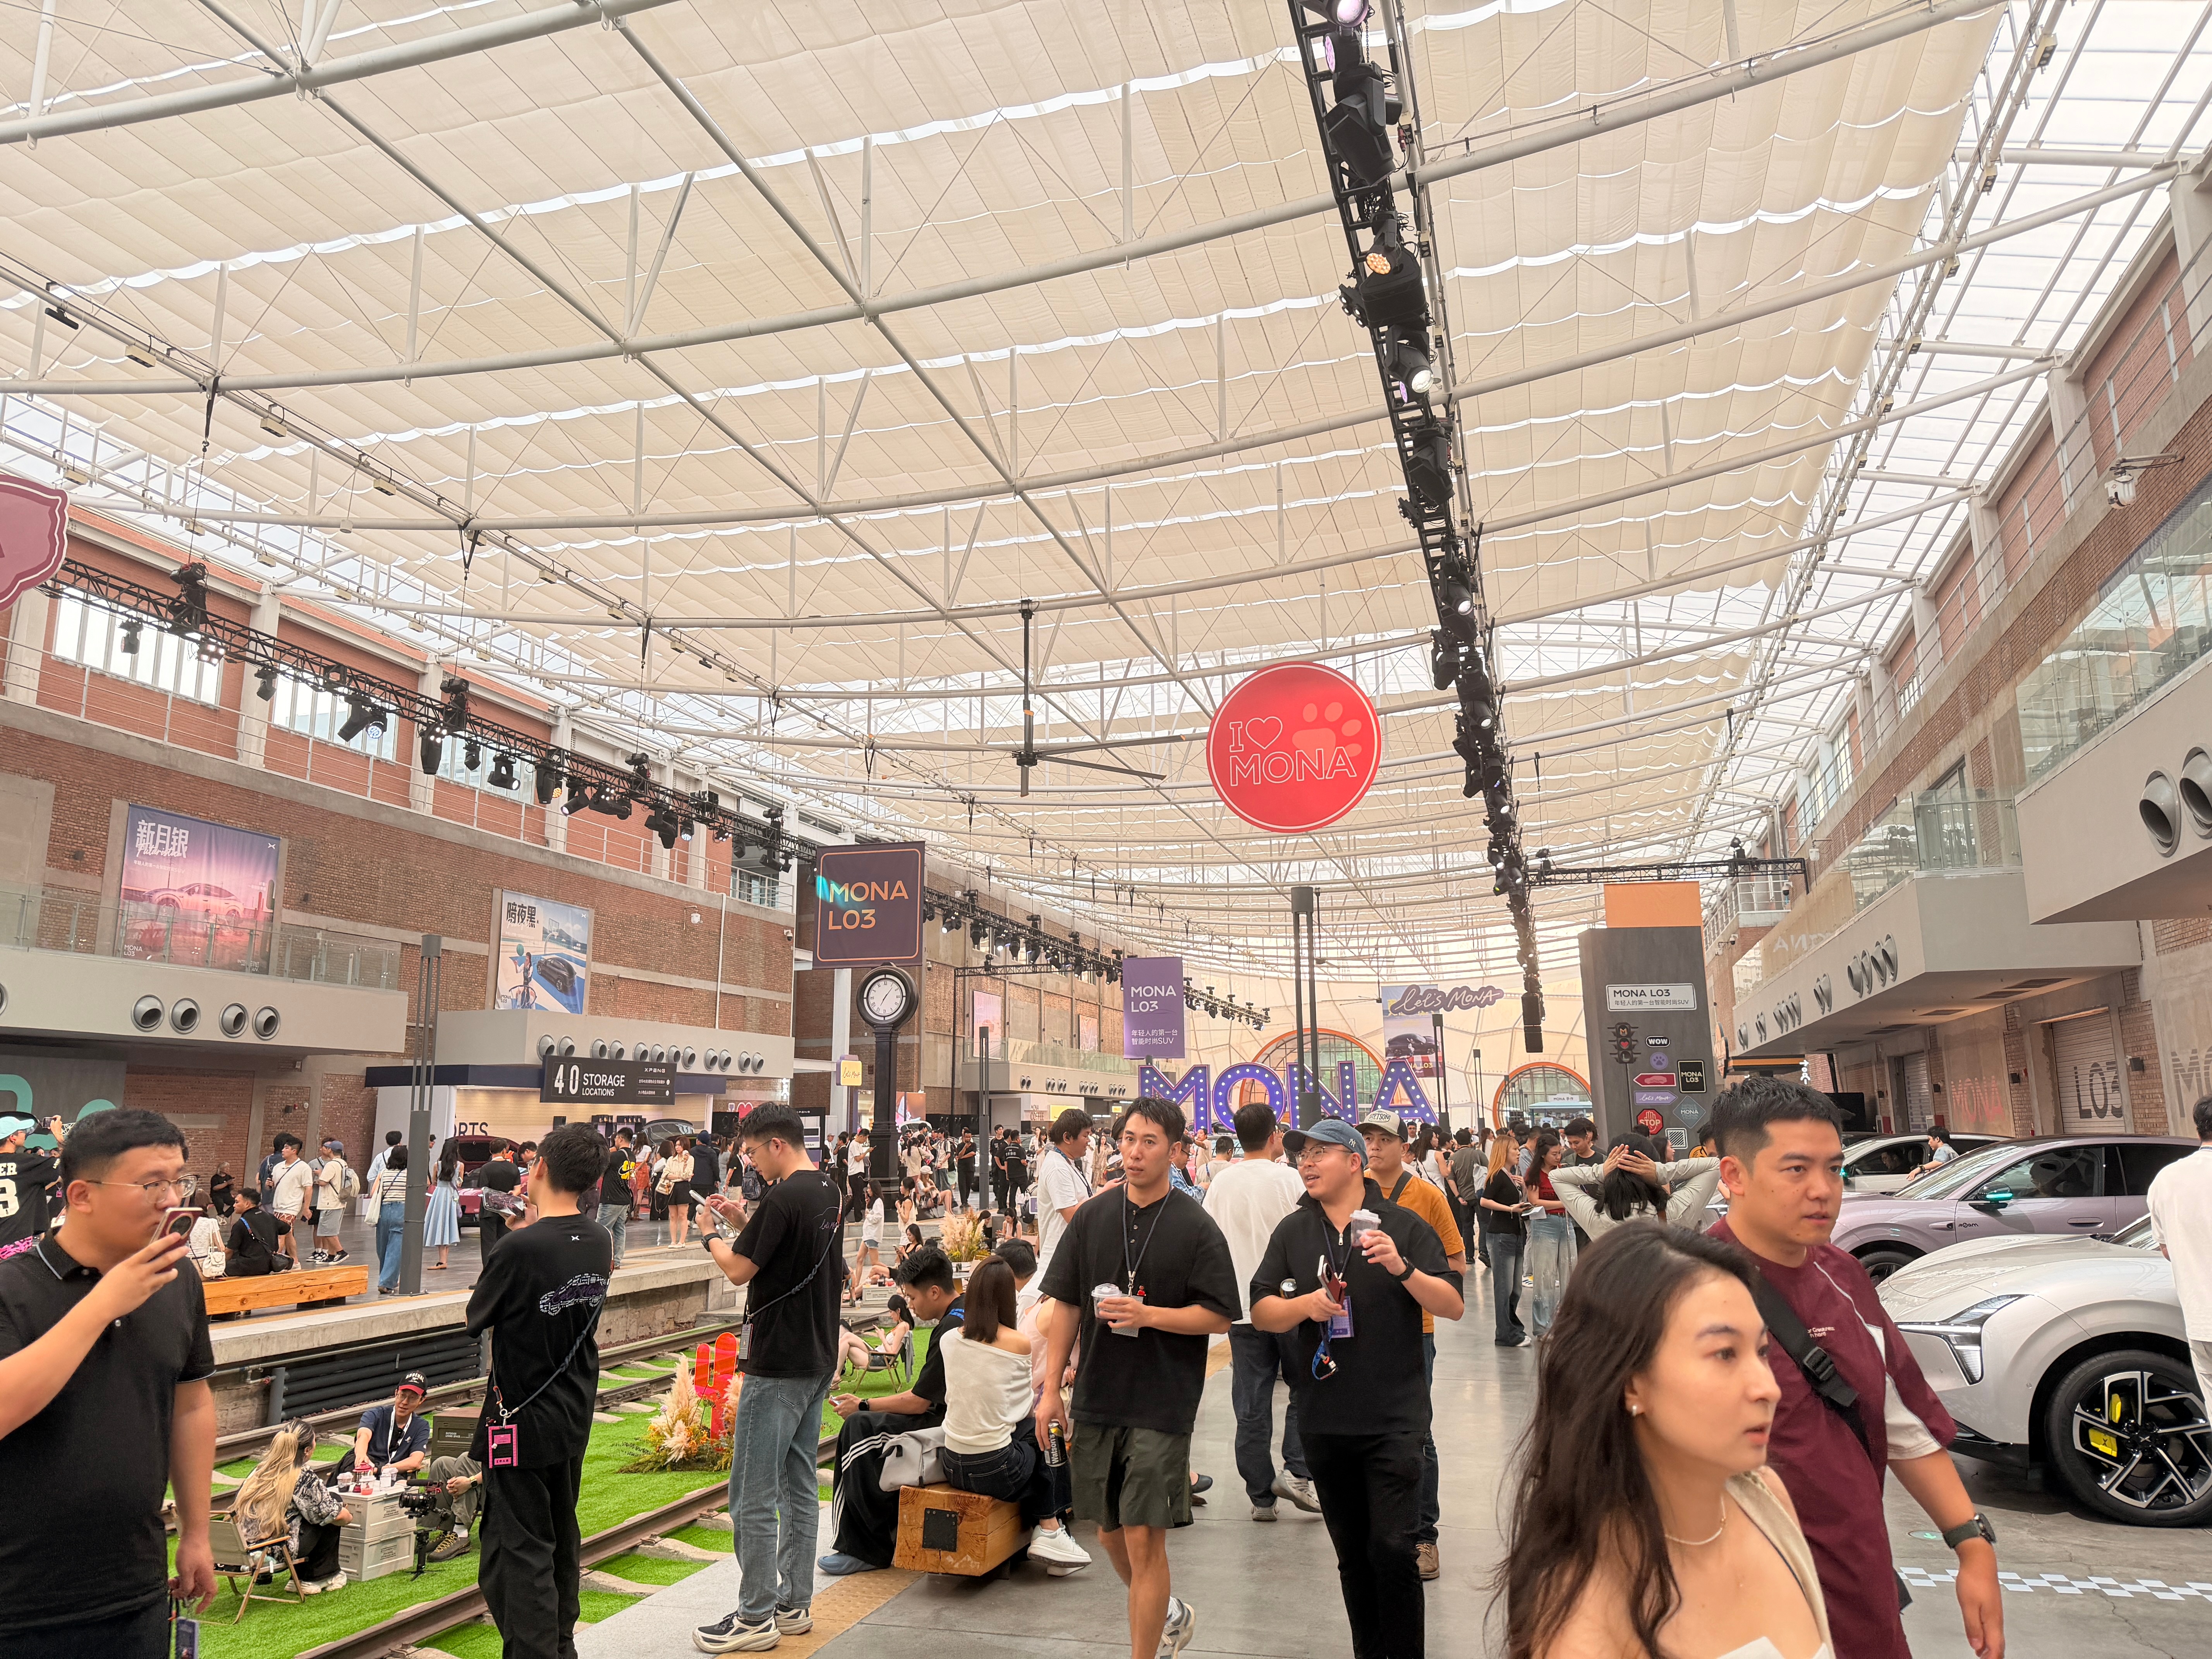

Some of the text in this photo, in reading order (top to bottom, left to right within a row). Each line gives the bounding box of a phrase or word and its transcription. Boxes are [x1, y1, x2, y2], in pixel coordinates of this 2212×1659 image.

[1229, 721, 1244, 752] I
[1229, 747, 1357, 787] MONA
[136, 819, 189, 859] 新月银
[829, 880, 909, 903] MONA
[1131, 985, 1176, 998] MONA
[582, 1087, 615, 1097] LOCATIONS
[583, 1073, 625, 1087] STORAGE
[1139, 1060, 1439, 1136] MONA
[1951, 1075, 2005, 1123] MONA
[453, 1122, 488, 1137] RTS
